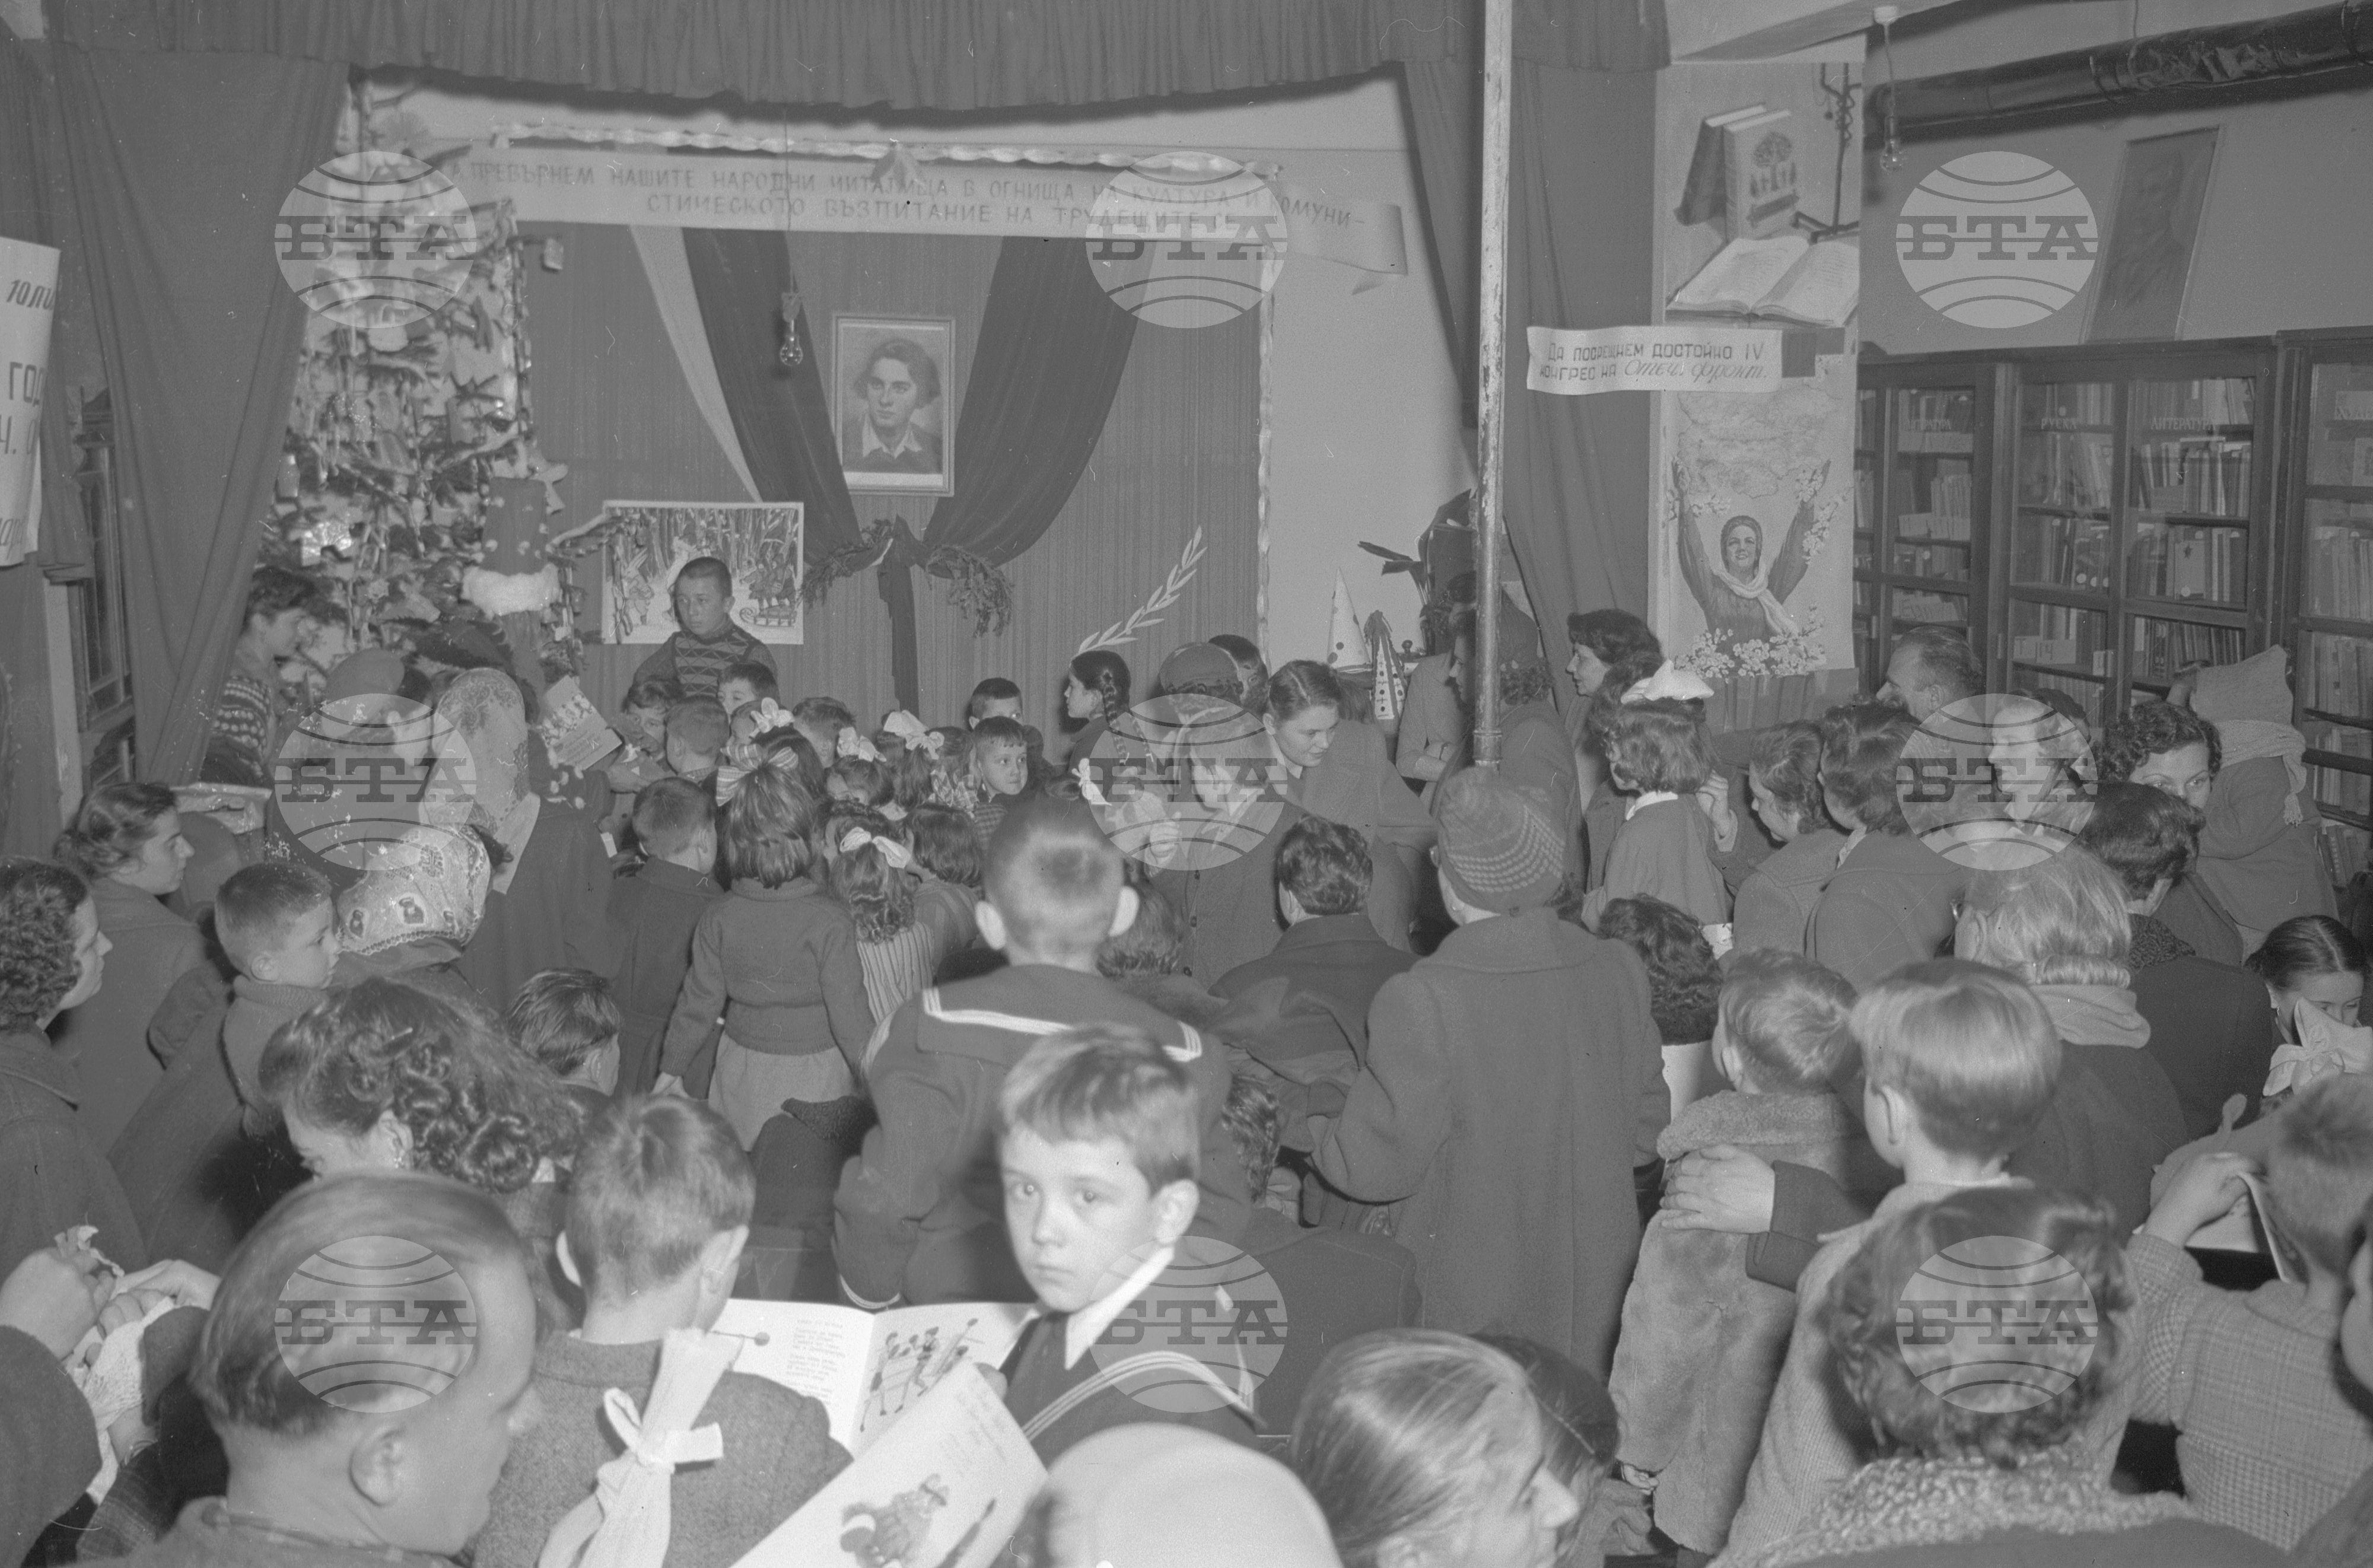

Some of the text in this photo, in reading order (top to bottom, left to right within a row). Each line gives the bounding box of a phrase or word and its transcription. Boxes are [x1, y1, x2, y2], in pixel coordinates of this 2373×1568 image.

[610, 168, 695, 190] НАШИТЕ
[711, 170, 815, 193] НАРОДНИ
[963, 180, 975, 197] В
[989, 179, 1074, 201] ОГНИЩА
[647, 193, 805, 217] СТИЧЕСКО
[824, 198, 991, 224] ВЪЗПИТАНИЕ
[1006, 206, 1033, 224] НА
[1652, 342, 1732, 360] ДОСТОЙНО
[1745, 342, 1764, 360] IV
[1601, 364, 1617, 379] НА
